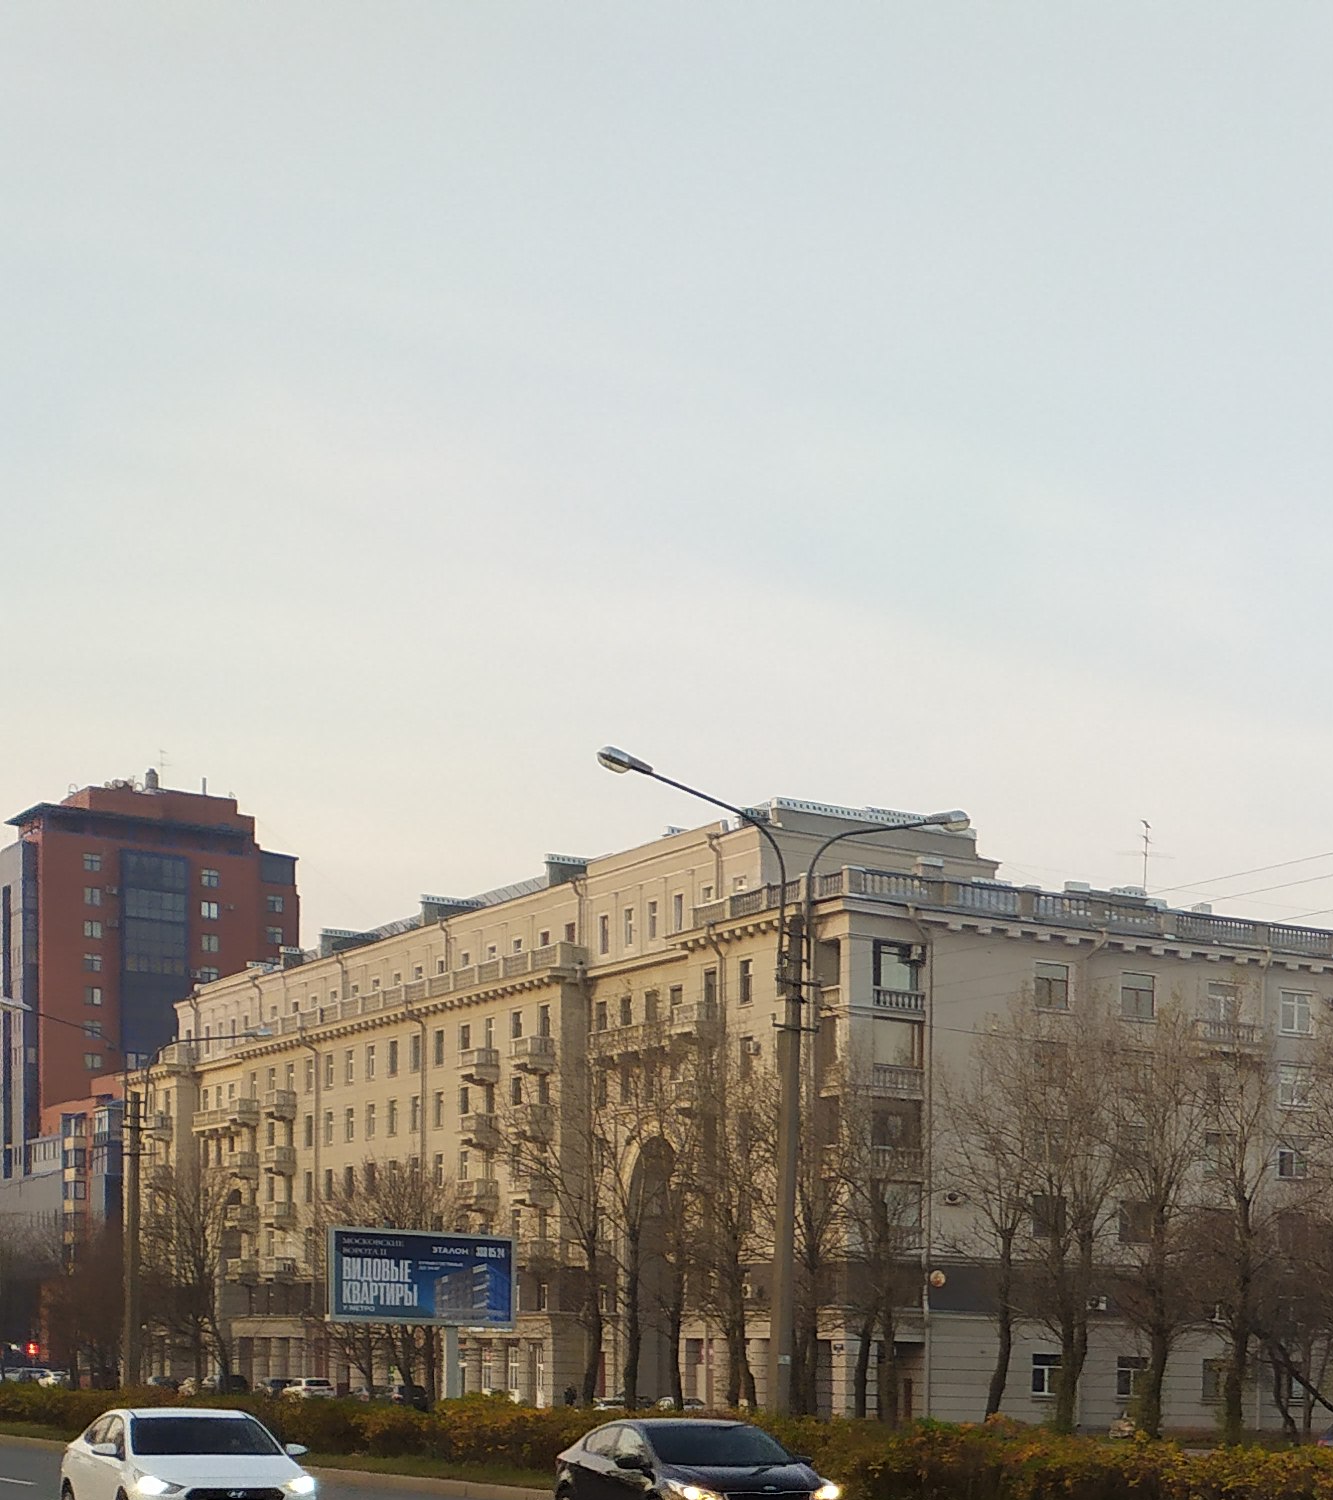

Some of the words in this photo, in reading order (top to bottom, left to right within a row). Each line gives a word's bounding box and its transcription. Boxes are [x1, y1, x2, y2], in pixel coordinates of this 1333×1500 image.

[432, 1246, 469, 1255] ЭТАЛОН
[342, 1257, 413, 1282] ВИДОВЫЕ
[342, 1281, 418, 1307] КВАРТИРЫ
